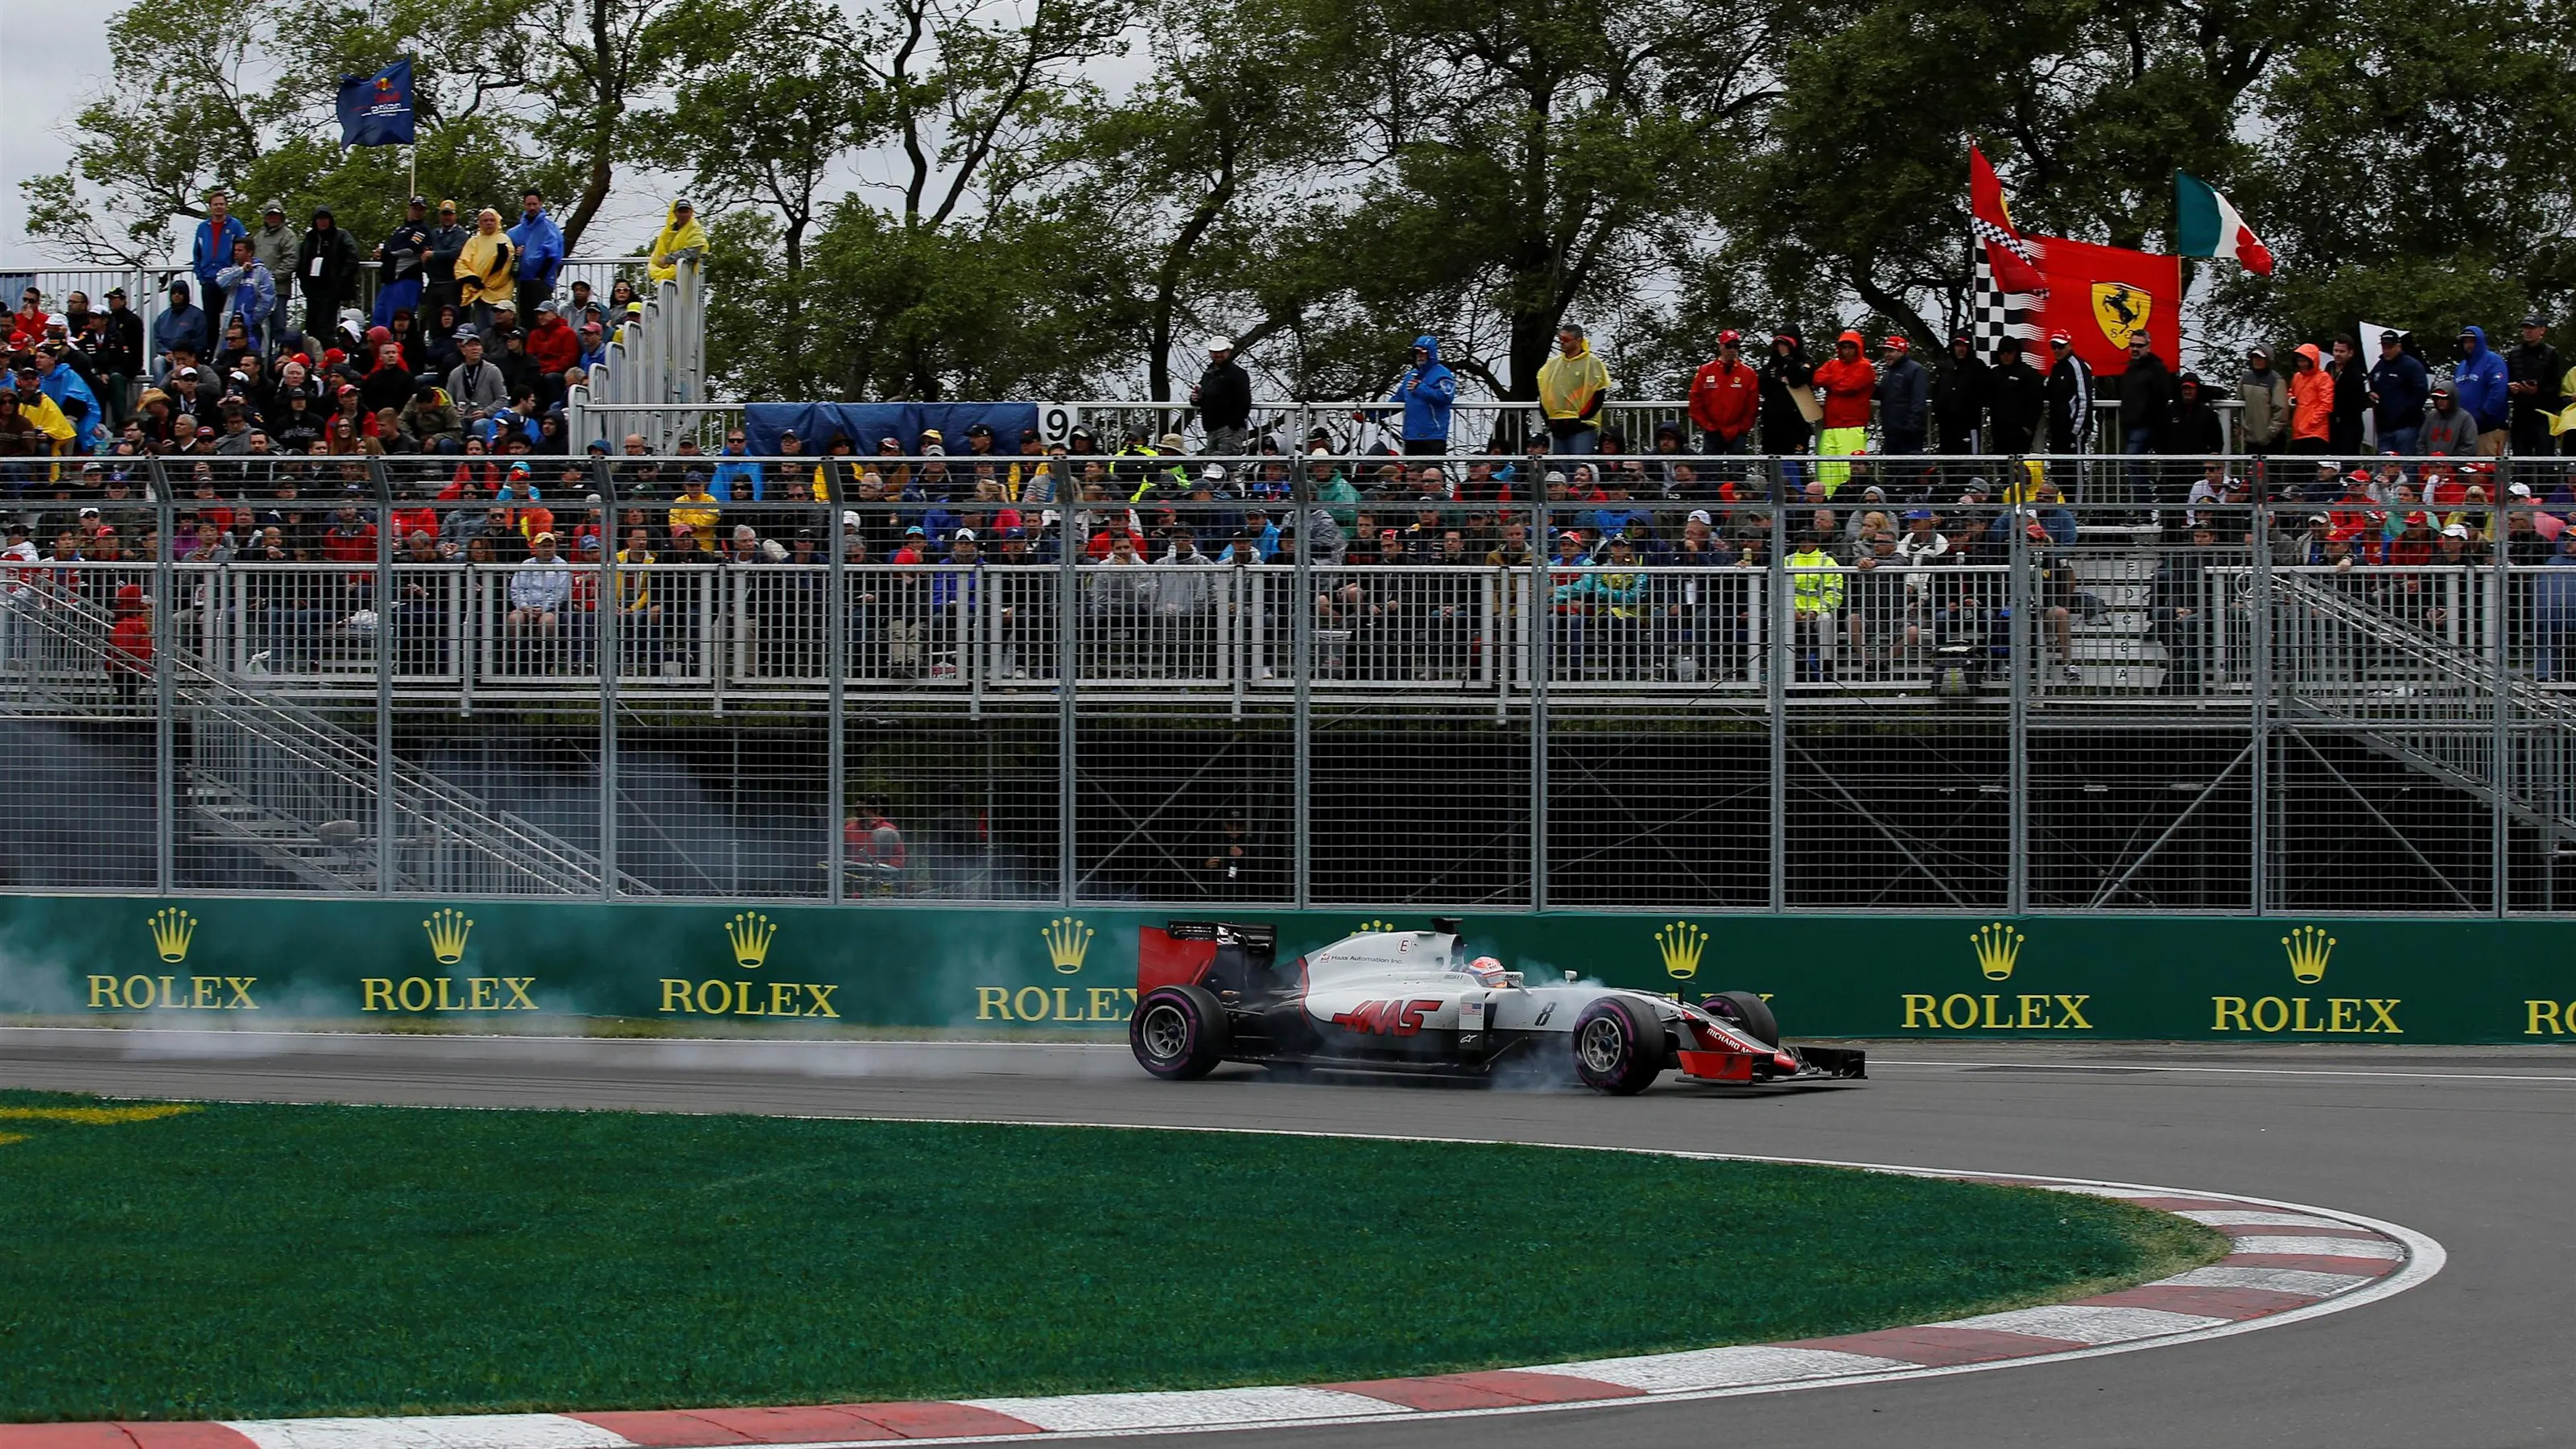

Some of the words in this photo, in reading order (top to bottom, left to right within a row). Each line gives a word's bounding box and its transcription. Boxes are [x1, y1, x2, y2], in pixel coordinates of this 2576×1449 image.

[1046, 409, 1069, 441] 9
[1349, 956, 1389, 964] Automation
[1400, 940, 1409, 952] E
[87, 975, 259, 1009] ROLEX
[361, 976, 539, 1012] ROLEX
[659, 979, 840, 1018] ROLEX
[1331, 1000, 1444, 1037] HAAS
[1534, 1001, 1557, 1026] 8
[1901, 993, 2093, 1029] ROLEX
[2211, 996, 2404, 1033] ROLEX
[1707, 1027, 1740, 1050] RICHARD
